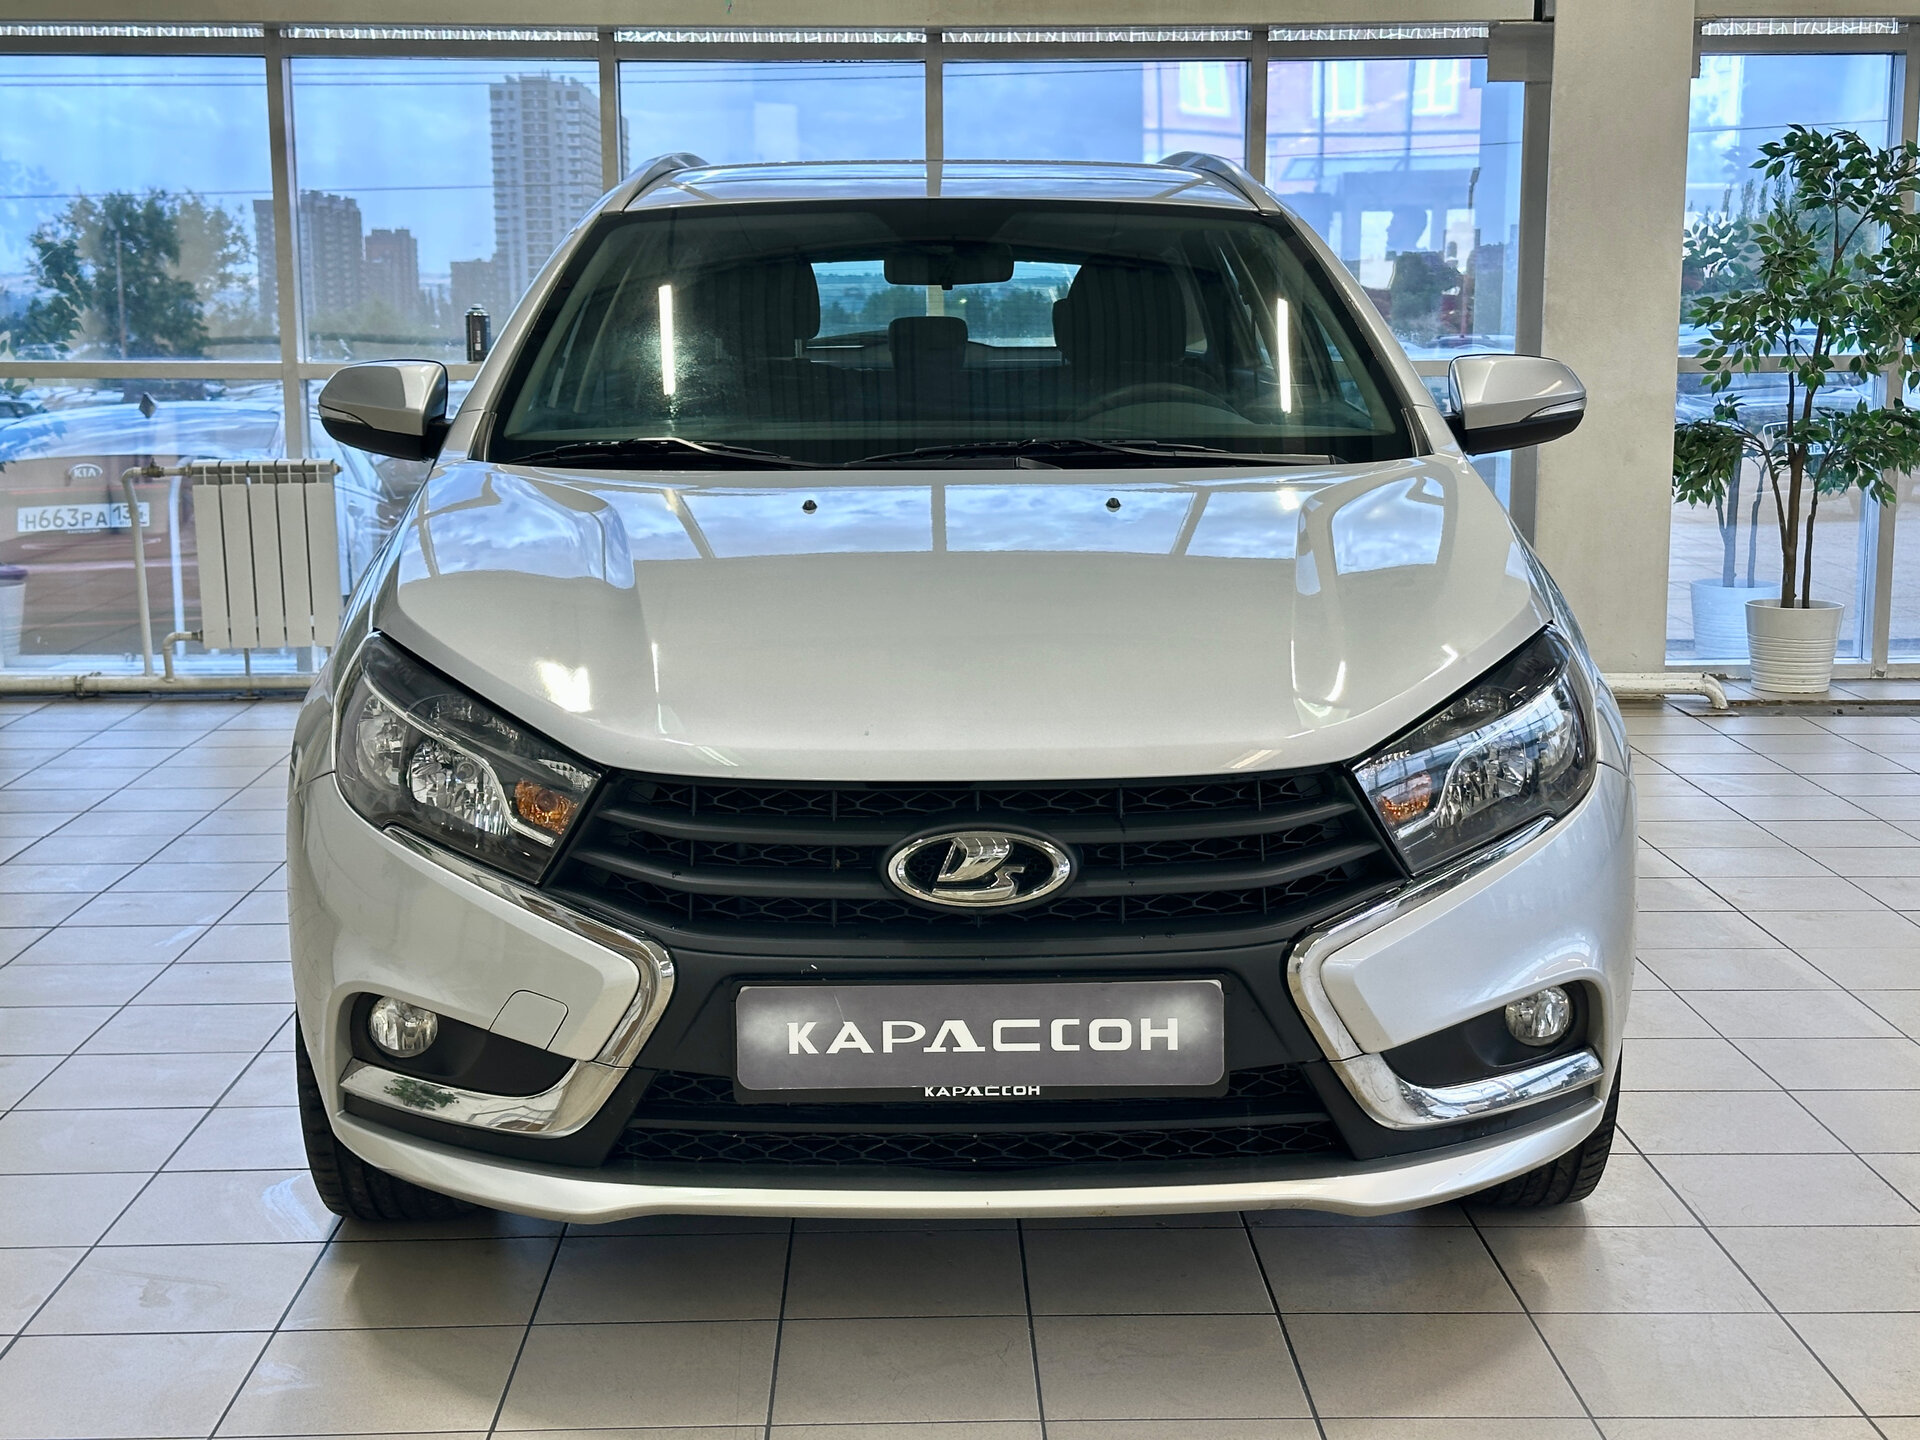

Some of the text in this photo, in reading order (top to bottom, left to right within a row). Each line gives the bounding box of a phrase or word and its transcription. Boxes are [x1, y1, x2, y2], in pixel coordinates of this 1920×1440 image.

[73, 468, 97, 478] KIA
[787, 1018, 1178, 1054] КАРАССОН
[924, 1085, 1040, 1097] КАРАССОН
